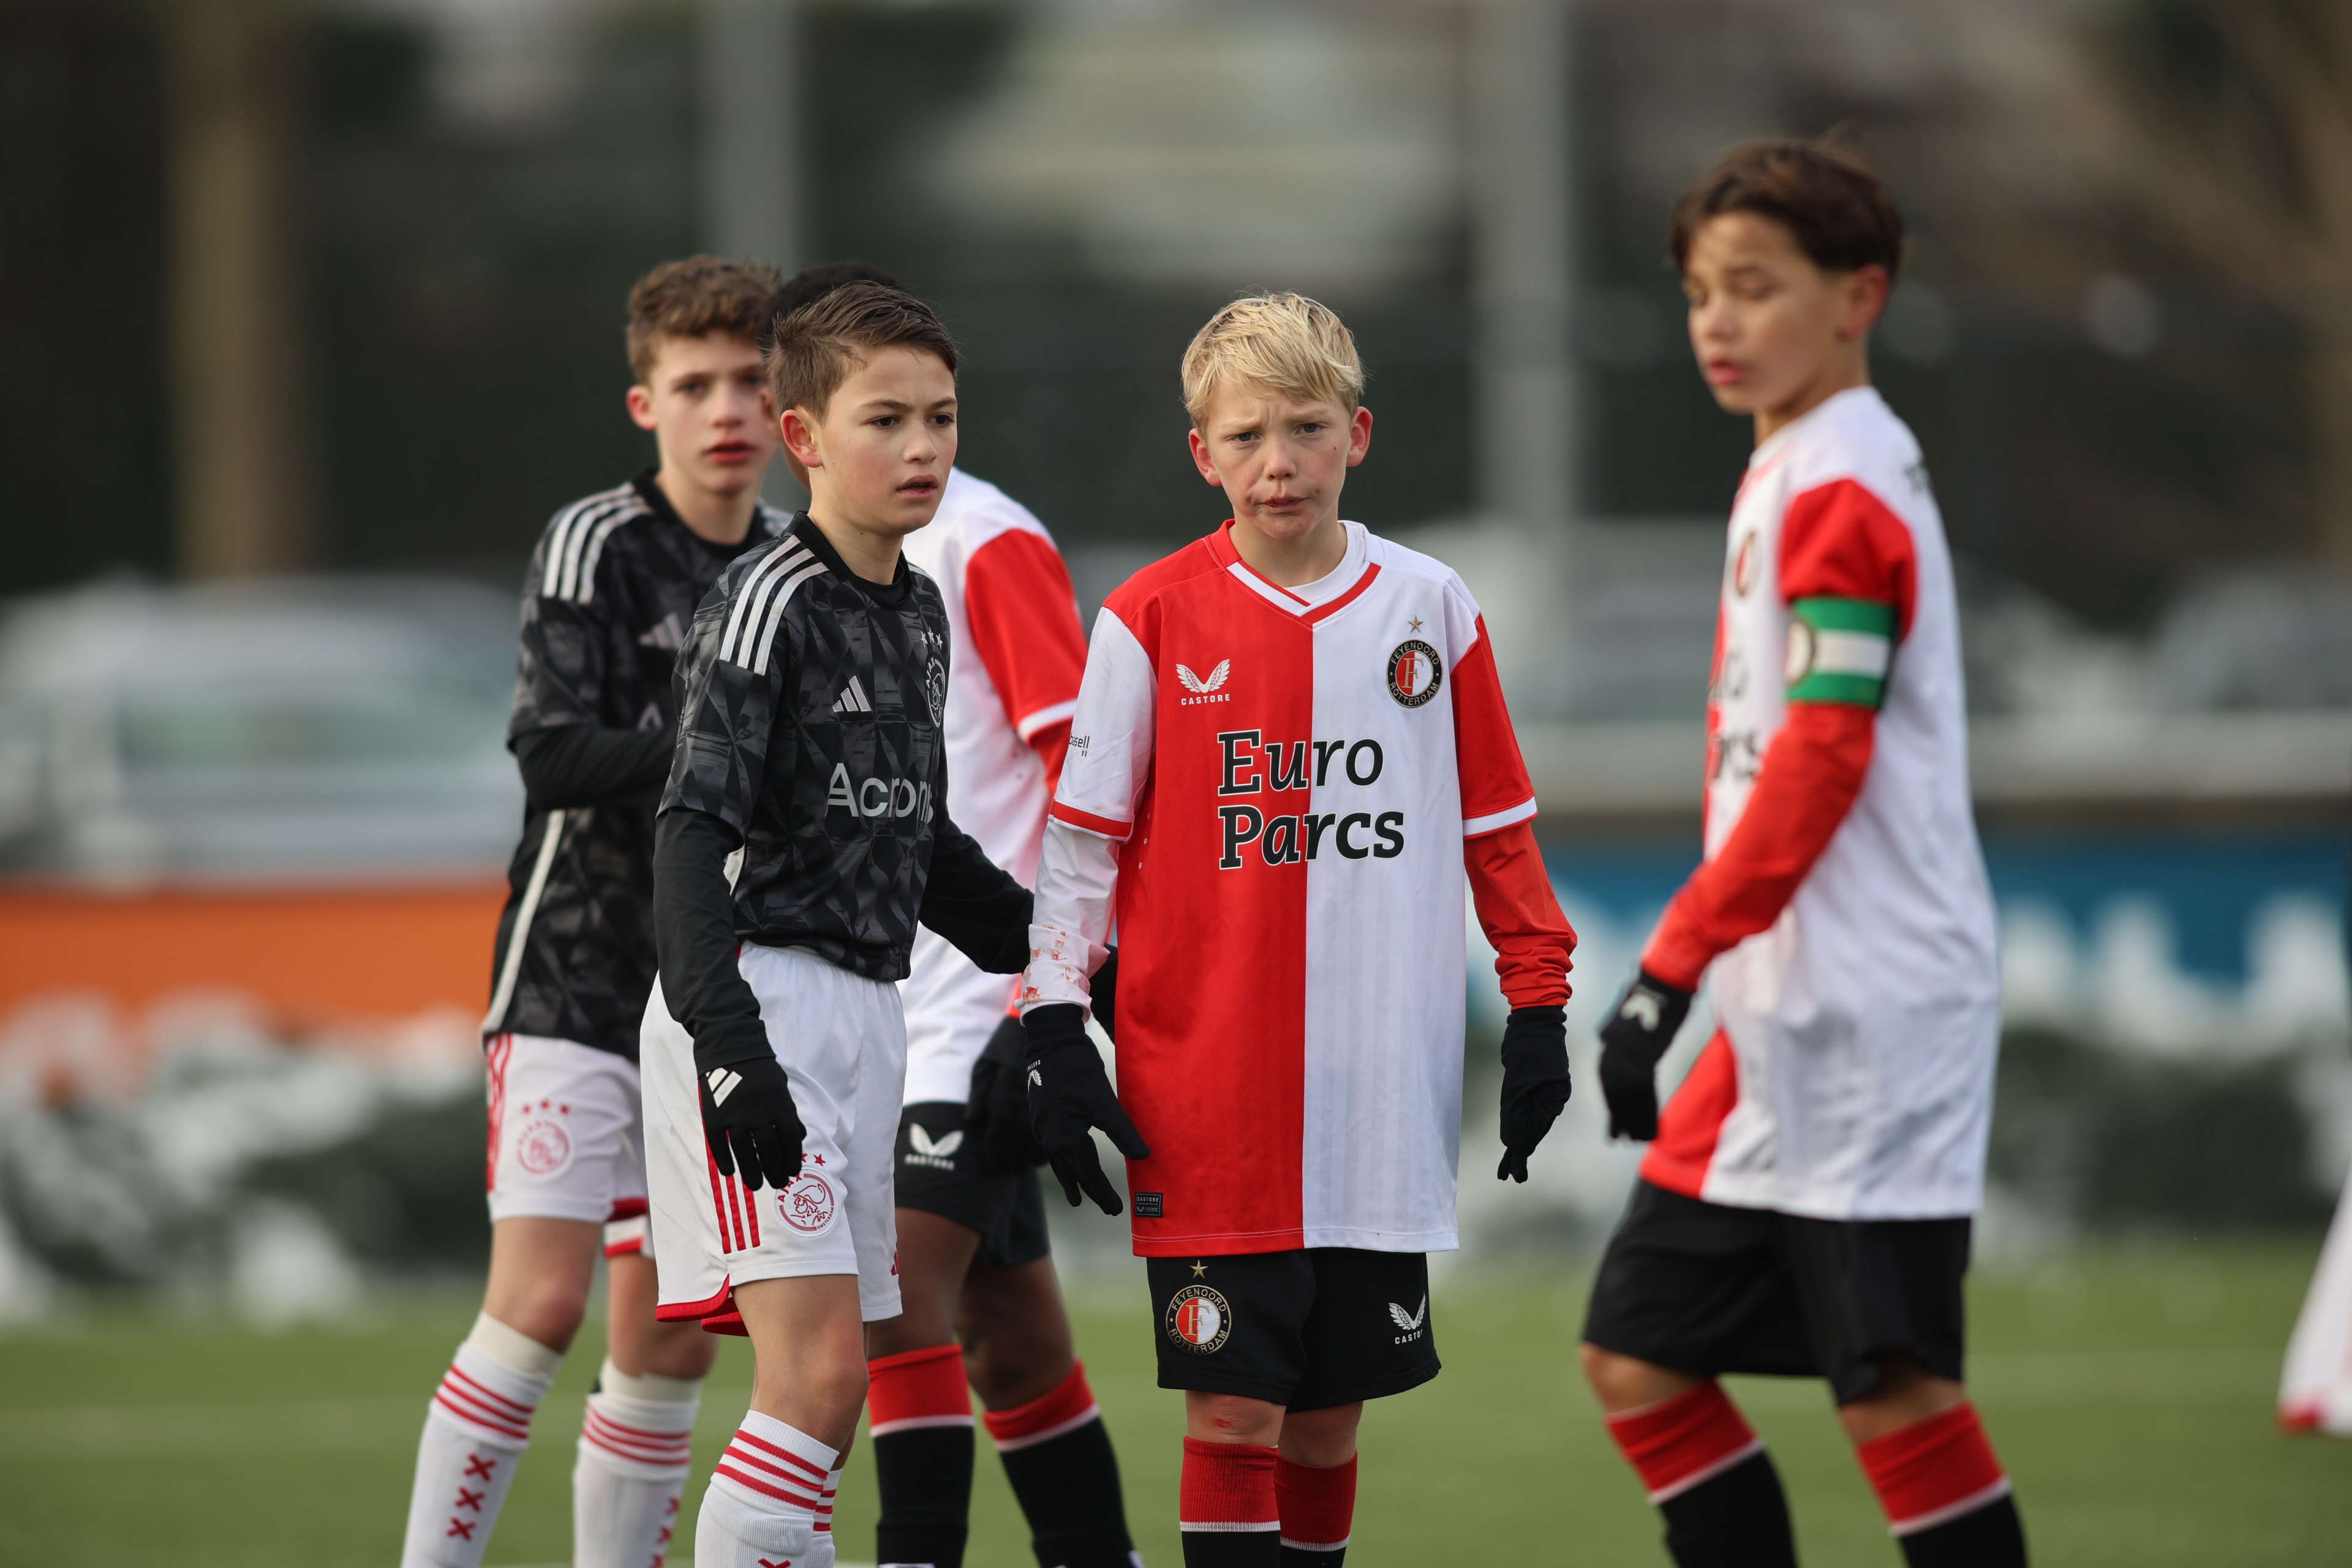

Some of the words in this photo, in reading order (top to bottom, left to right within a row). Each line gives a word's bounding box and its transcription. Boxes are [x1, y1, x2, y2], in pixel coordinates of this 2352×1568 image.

[1391, 642, 1439, 665] FEYENOORD
[1181, 693, 1231, 706] CASTORE
[1390, 682, 1439, 706] ROTTERDAM
[1218, 729, 1384, 796] Euro
[1218, 804, 1405, 870] Parcs
[1171, 1287, 1227, 1312] FEYENOORD
[1169, 1328, 1228, 1354] ROTTERDAM
[1395, 1328, 1423, 1344] CASTO
